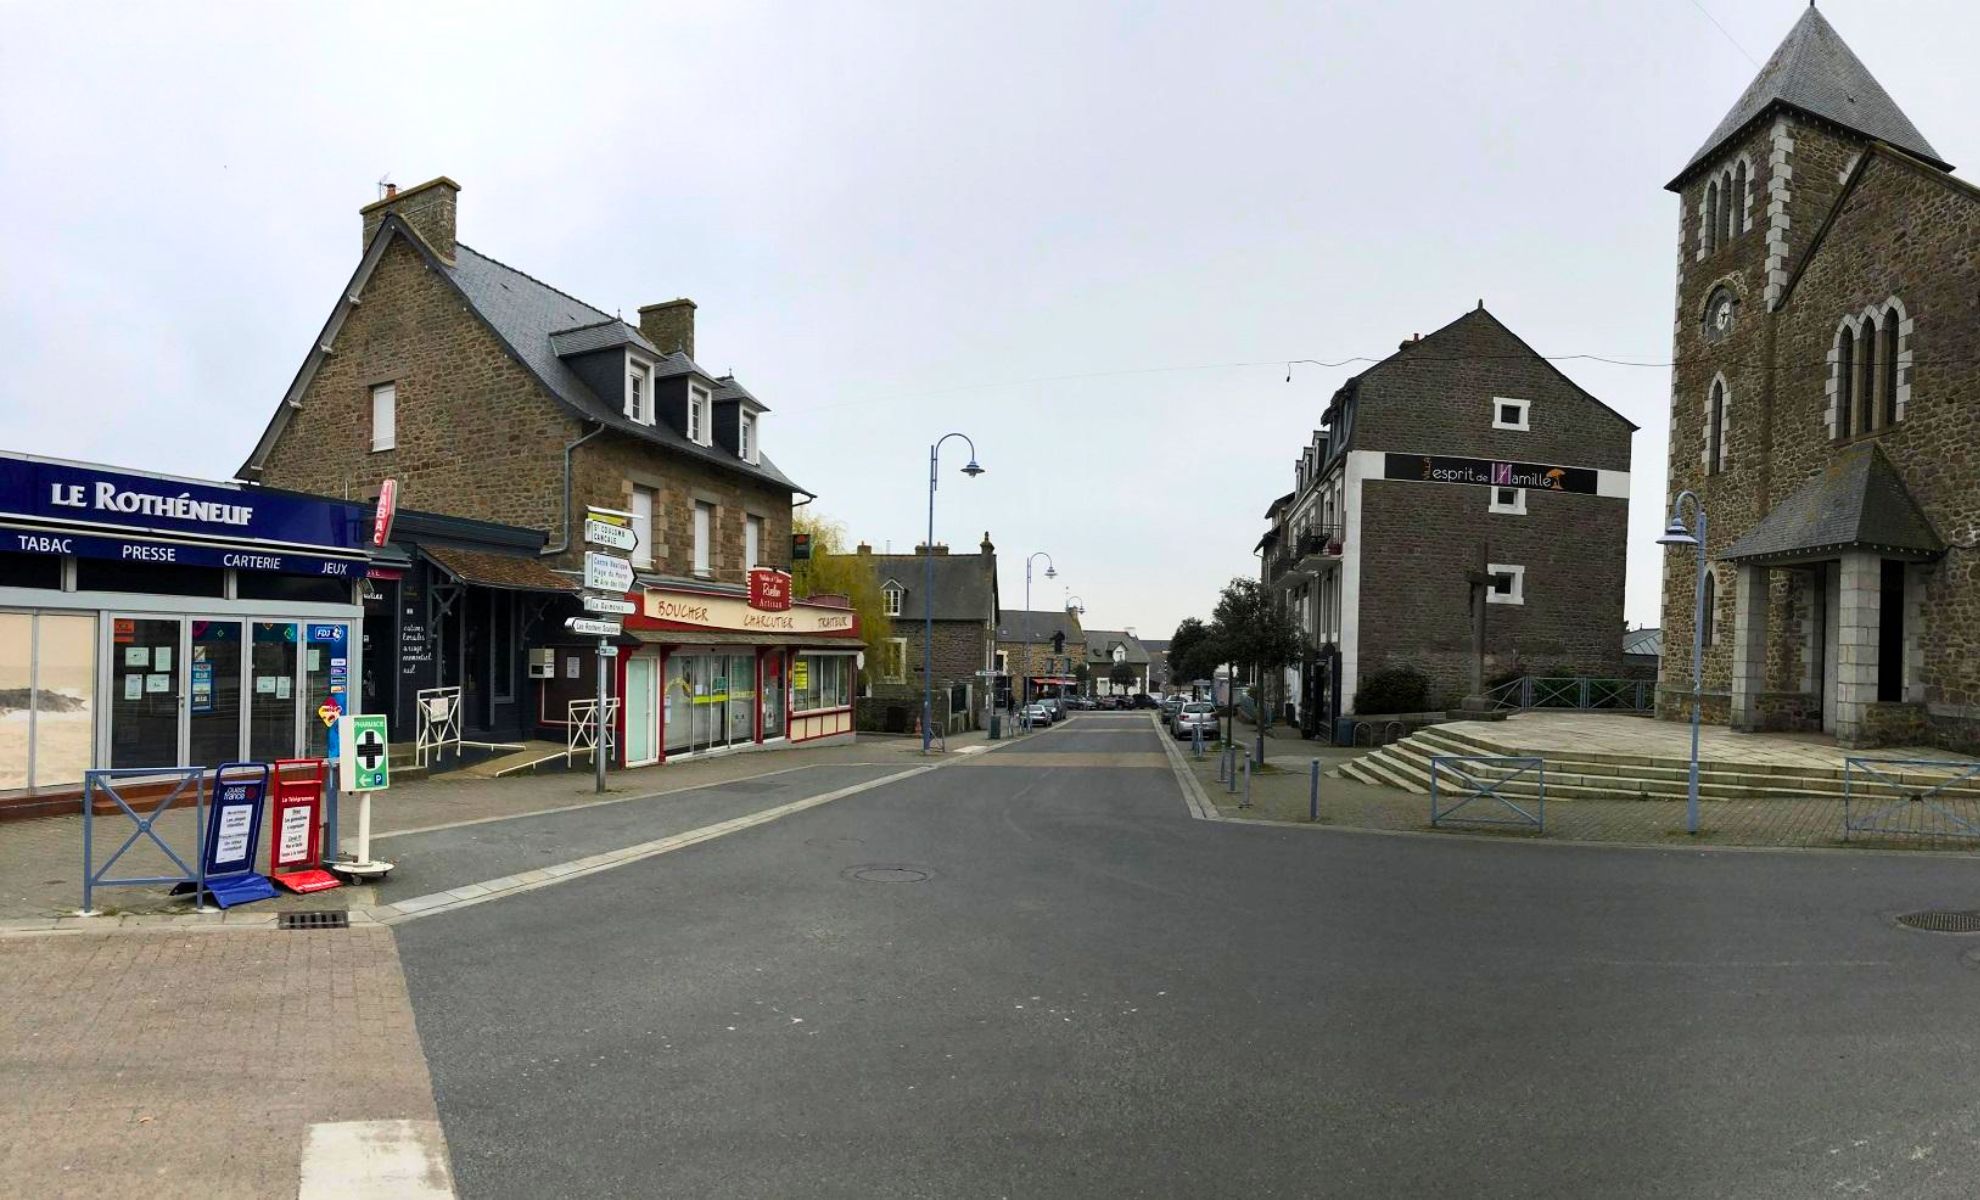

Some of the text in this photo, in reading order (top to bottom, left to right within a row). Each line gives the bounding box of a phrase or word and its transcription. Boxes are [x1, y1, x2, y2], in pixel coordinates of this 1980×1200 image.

[1432, 466, 1475, 482] esprit
[1476, 474, 1489, 482] de
[51, 481, 253, 526] LE ROTHÉNEUF
[373, 482, 390, 546] TABAC
[18, 535, 72, 554] TABAC
[594, 533, 617, 544] CANCALE
[122, 545, 176, 562] PRESSE
[223, 554, 281, 570] CARTERIE
[321, 561, 348, 576] JEUX
[658, 601, 709, 621] BOUCHER
[759, 599, 783, 609] Artisan
[744, 614, 793, 629] CHARCUTIER
[818, 616, 848, 627] TRAITEUR
[317, 629, 331, 637] FDJ
